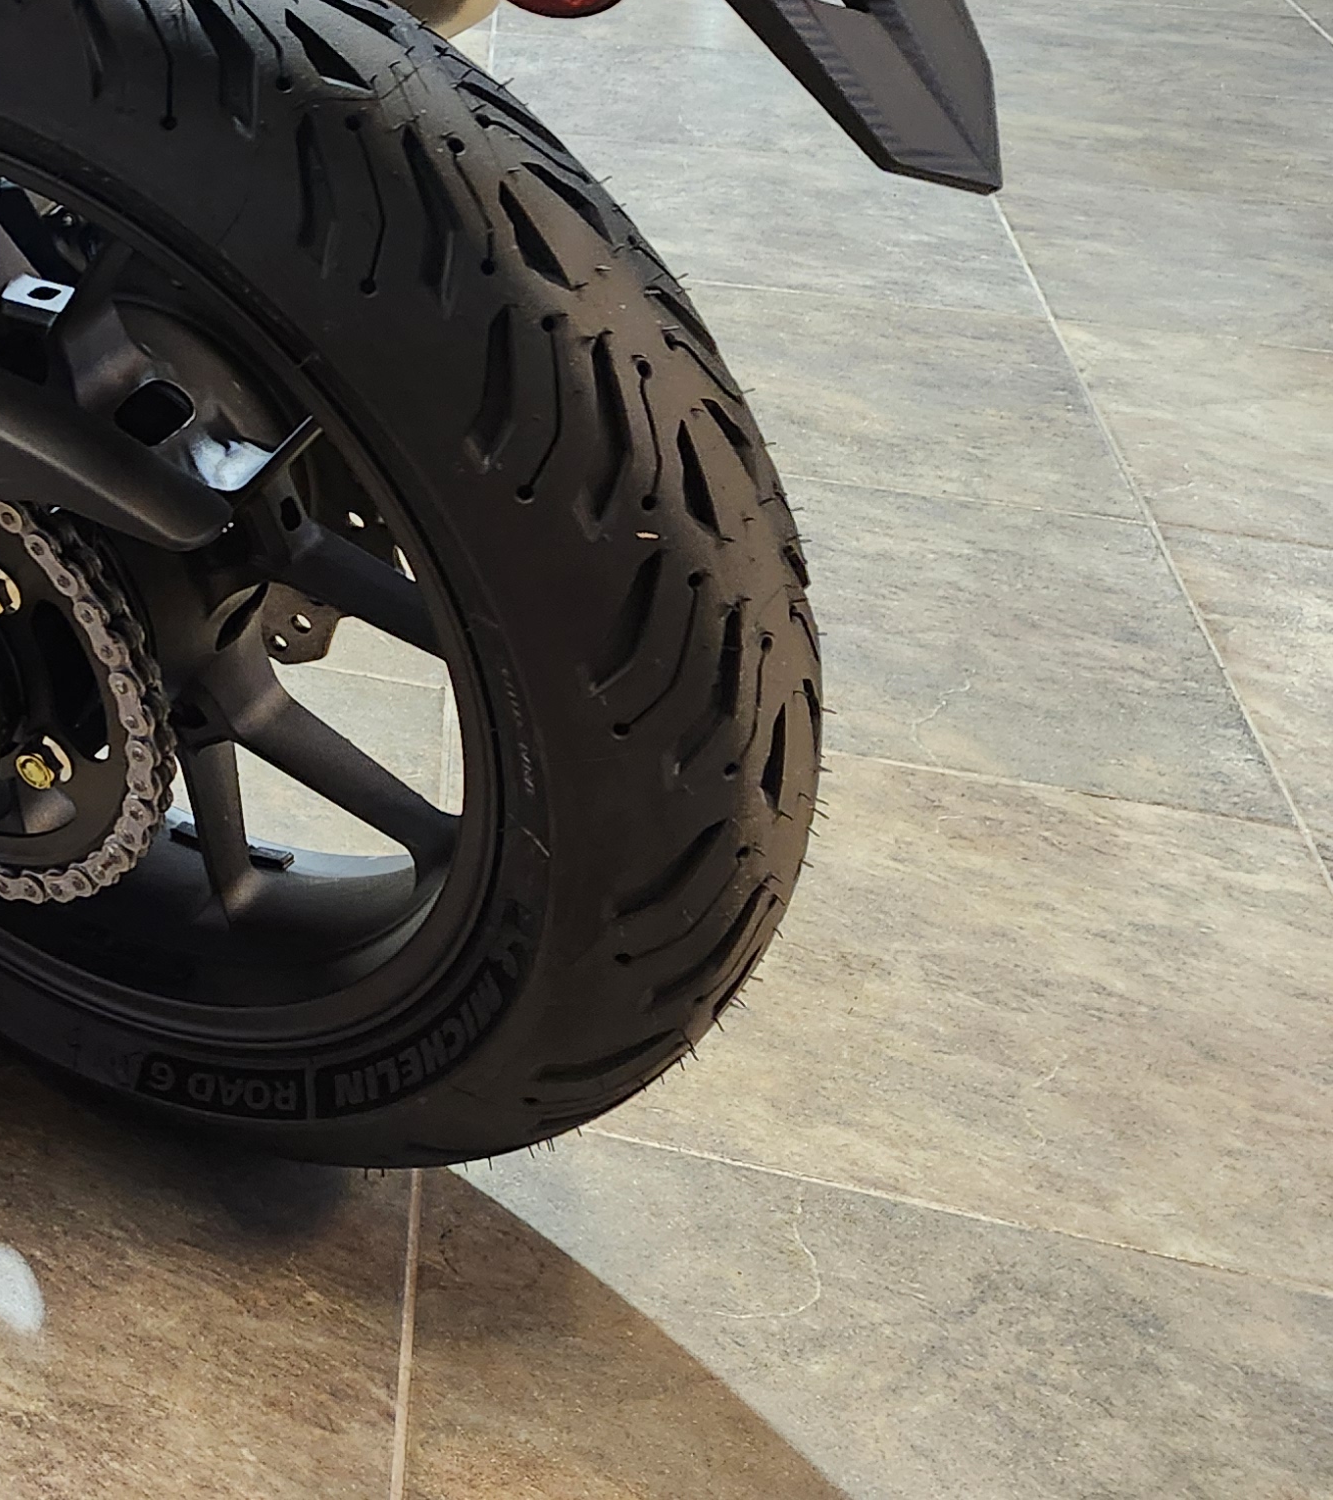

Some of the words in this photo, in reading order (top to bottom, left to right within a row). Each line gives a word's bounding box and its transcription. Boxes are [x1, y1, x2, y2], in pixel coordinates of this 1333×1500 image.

[334, 968, 505, 1110] MICHELIN
[148, 1062, 176, 1090] 6
[187, 1073, 298, 1112] ROAD
